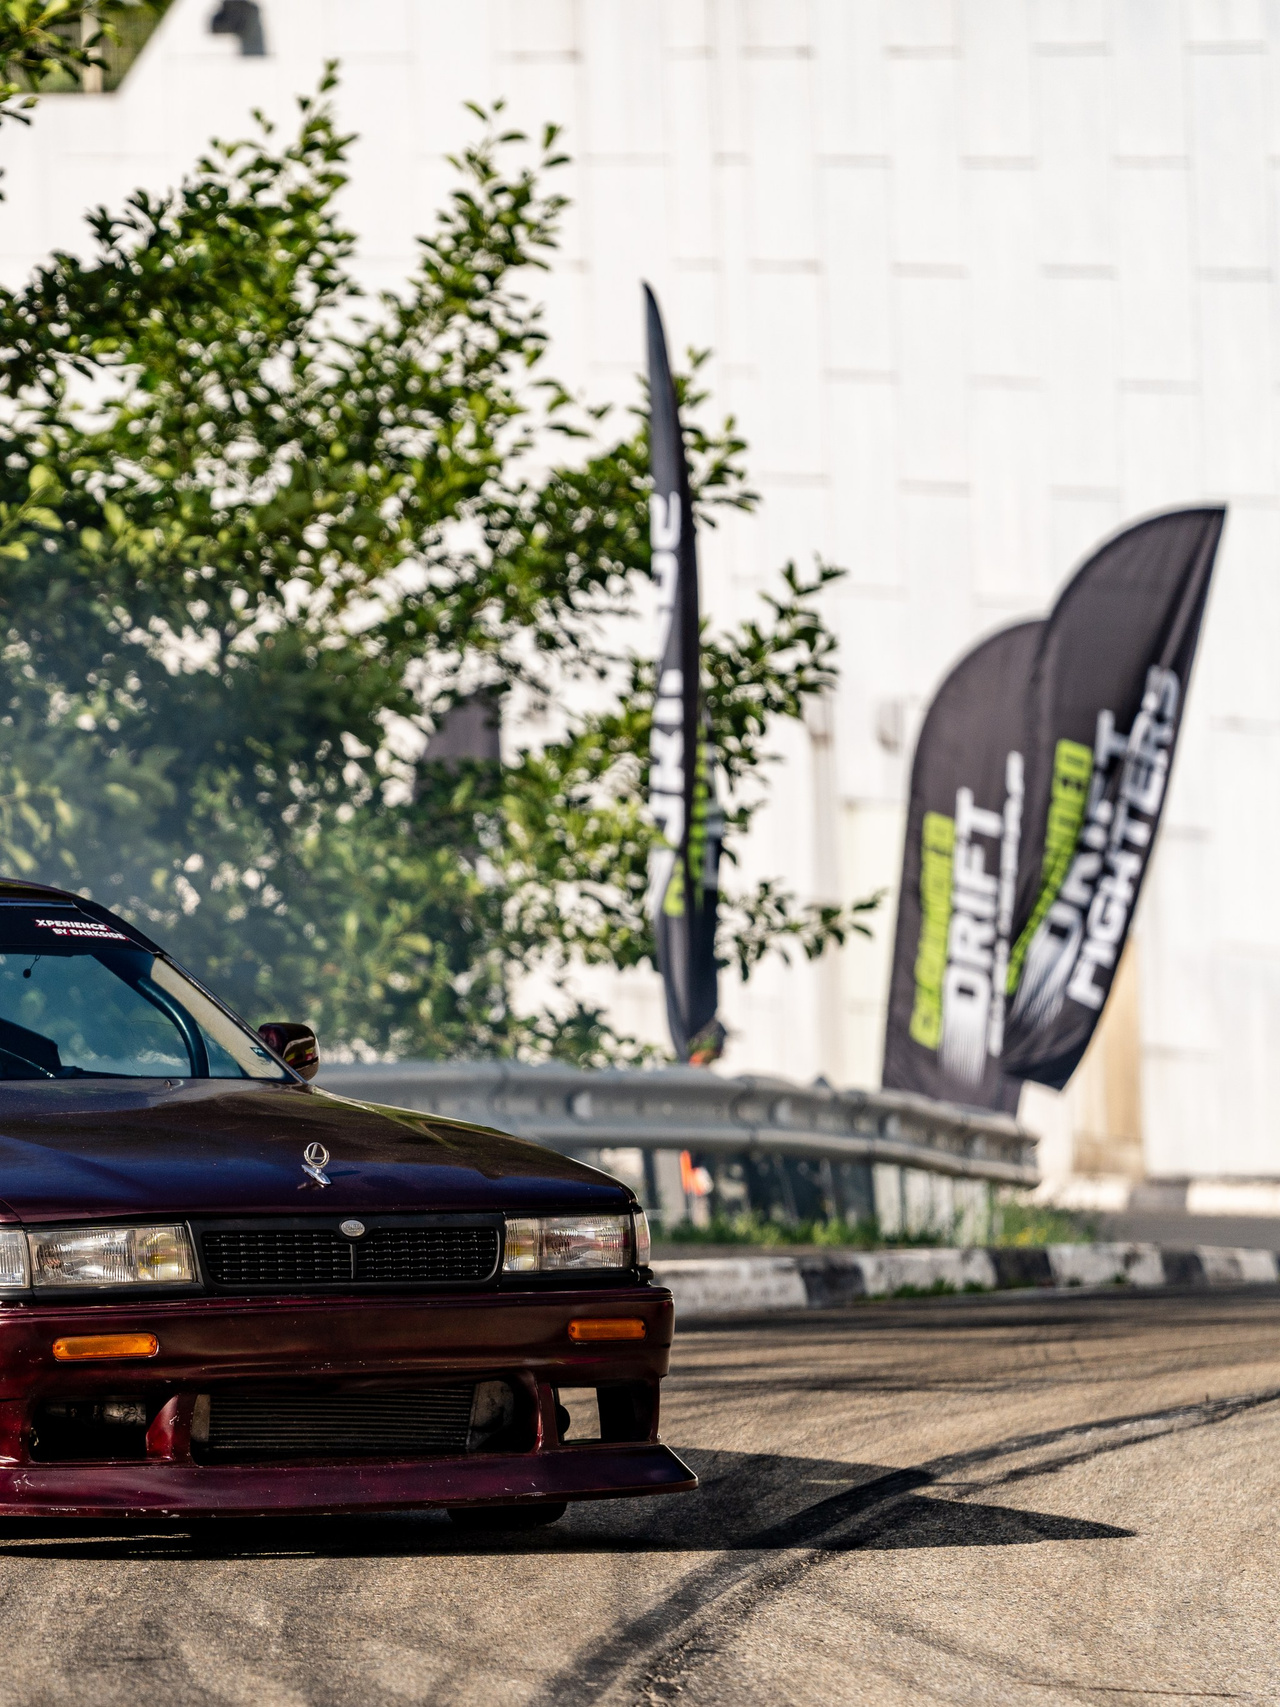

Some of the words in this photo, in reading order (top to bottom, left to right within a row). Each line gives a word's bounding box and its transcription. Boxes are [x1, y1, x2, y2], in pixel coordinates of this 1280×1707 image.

[1066, 663, 1181, 1009] FIGHTERS
[35, 919, 108, 931] XPERIENCE
[70, 928, 126, 940] DARKSIDE
[939, 786, 1004, 1084] DRIFT
